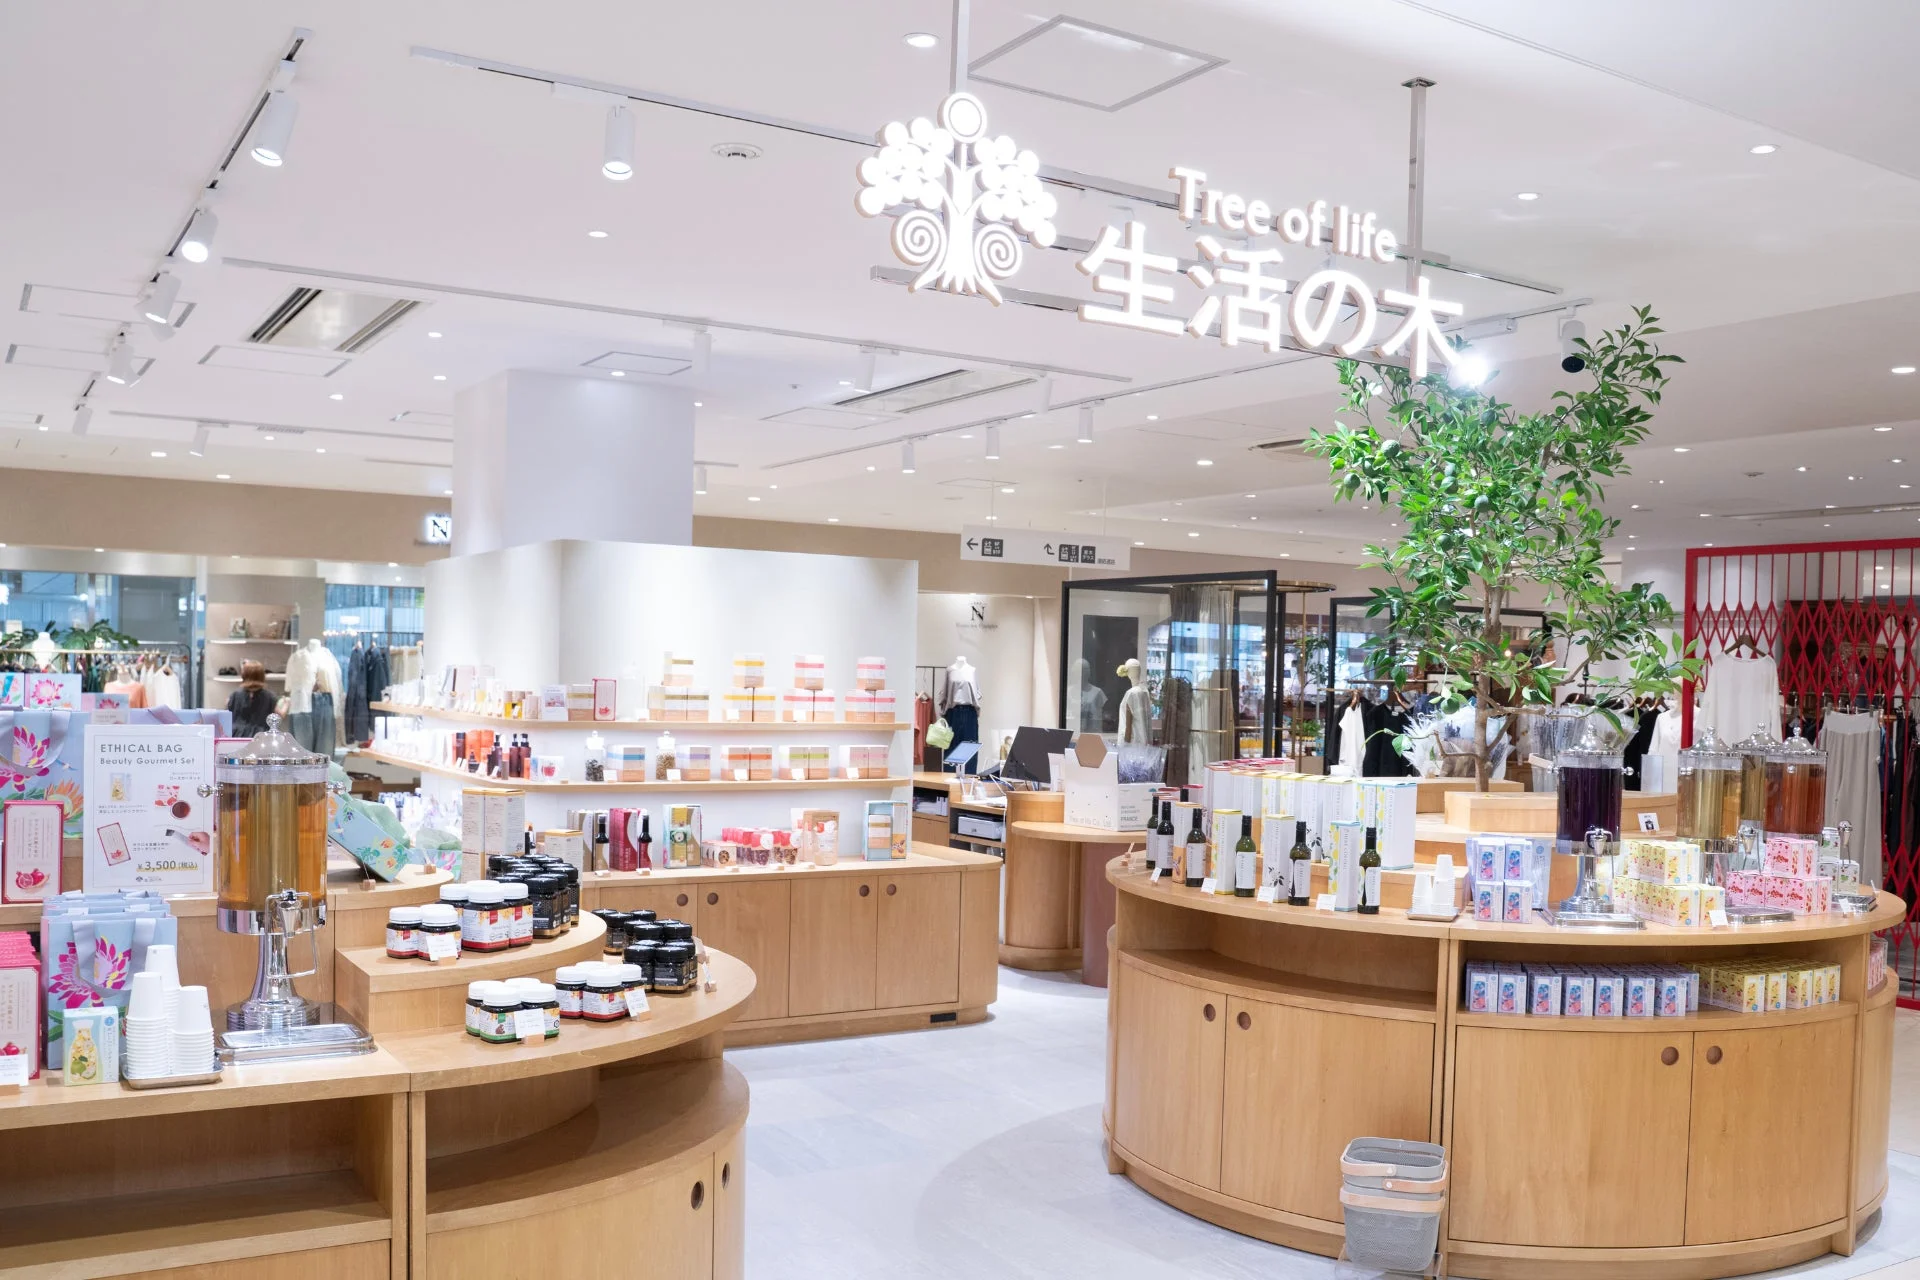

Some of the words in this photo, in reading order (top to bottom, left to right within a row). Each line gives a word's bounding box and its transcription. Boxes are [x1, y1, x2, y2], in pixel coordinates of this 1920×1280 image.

[1168, 166, 1272, 238] Tree
[1282, 199, 1328, 249] of
[1331, 204, 1399, 265] life
[1076, 221, 1464, 379] 生活の木
[971, 605, 985, 621] N
[100, 744, 152, 753] ETHICAL
[157, 744, 183, 753] BAG
[100, 757, 132, 766] Beauty
[136, 757, 177, 765] Gourmet
